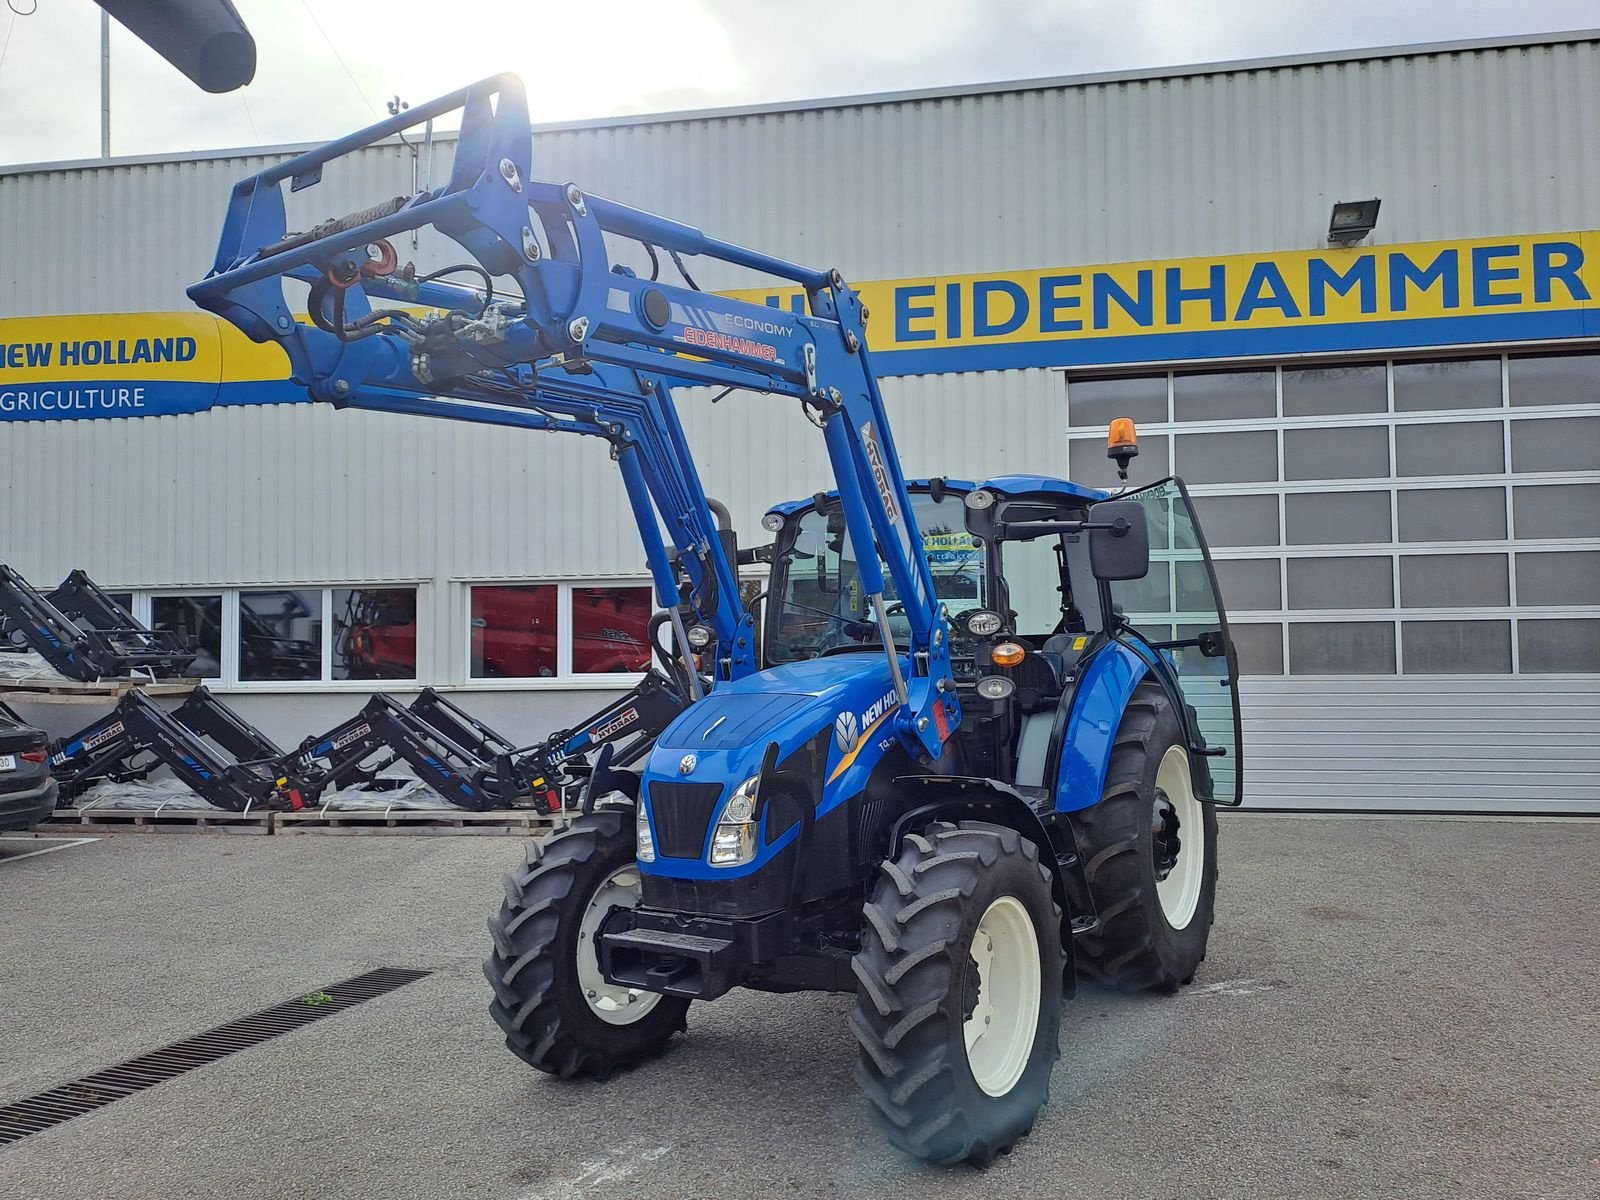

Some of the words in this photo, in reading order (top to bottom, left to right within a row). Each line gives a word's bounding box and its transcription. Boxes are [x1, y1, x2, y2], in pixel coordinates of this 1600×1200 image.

[895, 241, 1592, 342] EIDENHAMMER
[724, 313, 794, 338] ECONOMY
[0, 342, 52, 368] EW
[60, 337, 197, 366] HOLLAND
[866, 441, 893, 520] HYDRAC
[598, 713, 636, 738] HYDRAC
[861, 698, 882, 730] NEW
[90, 727, 122, 747] HYDRAC
[340, 728, 369, 746] HYDRAC
